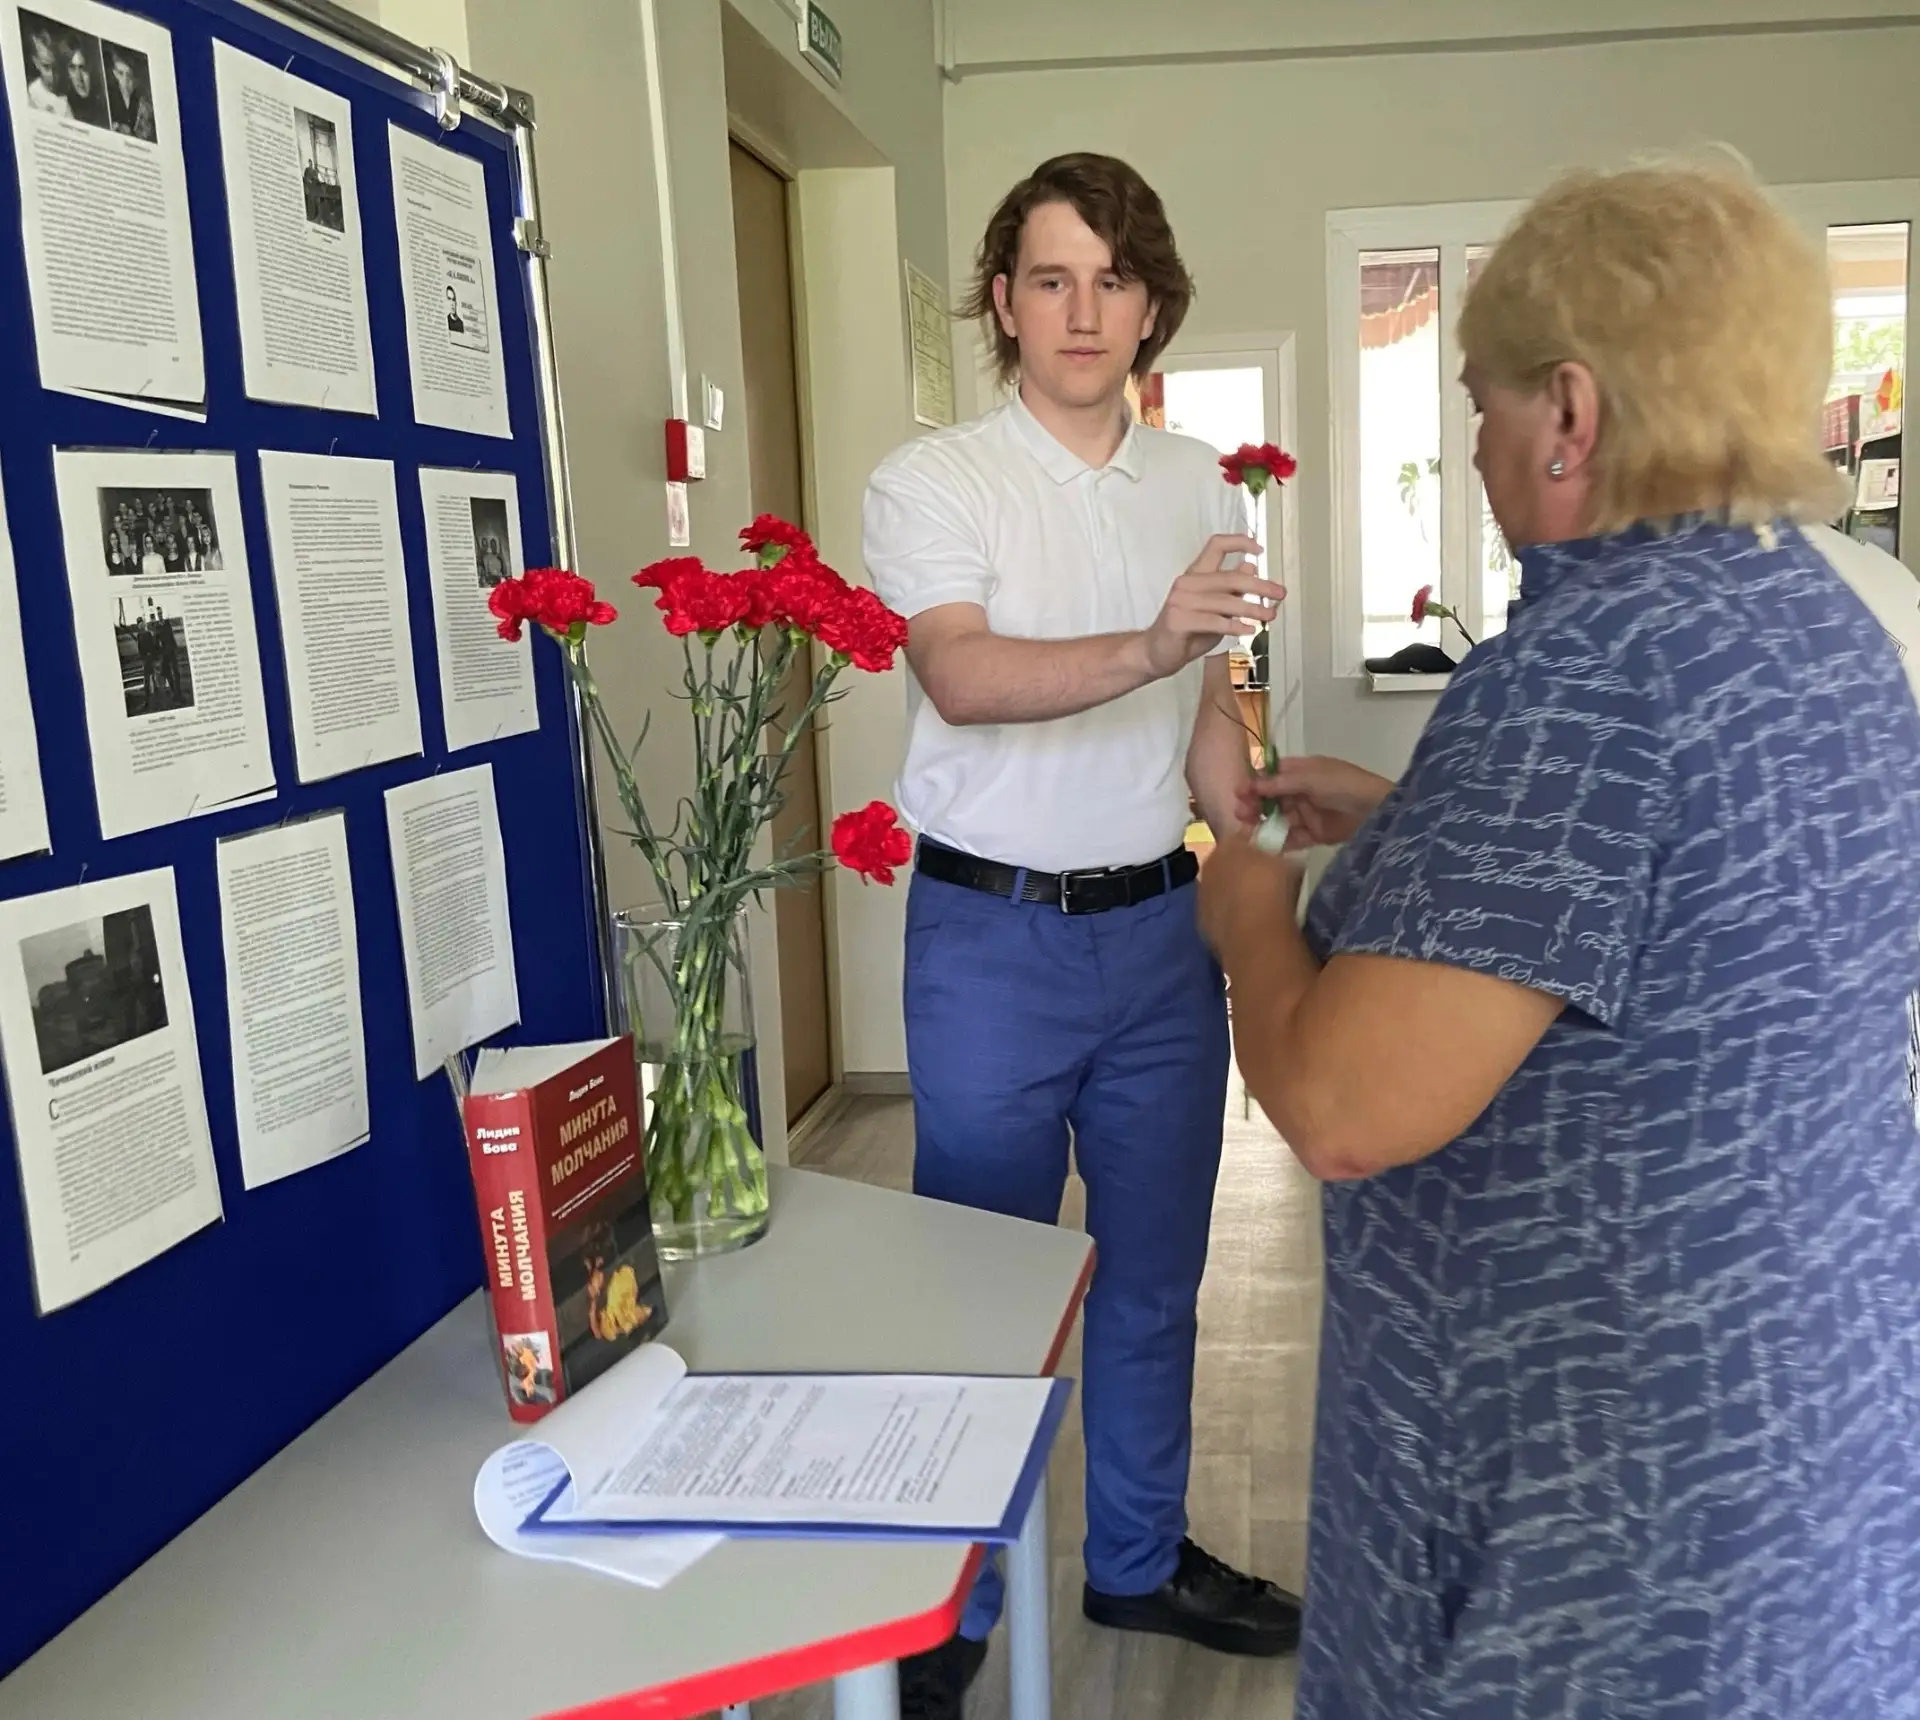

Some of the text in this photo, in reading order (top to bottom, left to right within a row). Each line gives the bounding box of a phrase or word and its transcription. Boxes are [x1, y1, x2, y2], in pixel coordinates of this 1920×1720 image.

[476, 1126, 520, 1140] Лидия
[482, 1141, 517, 1155] Бова
[559, 1095, 617, 1146] МИНУТА
[551, 1117, 628, 1186] МОЛЧАНИЯ
[491, 1207, 513, 1288] МИНУТА
[509, 1190, 536, 1301] МОЛЧАНИЯ
